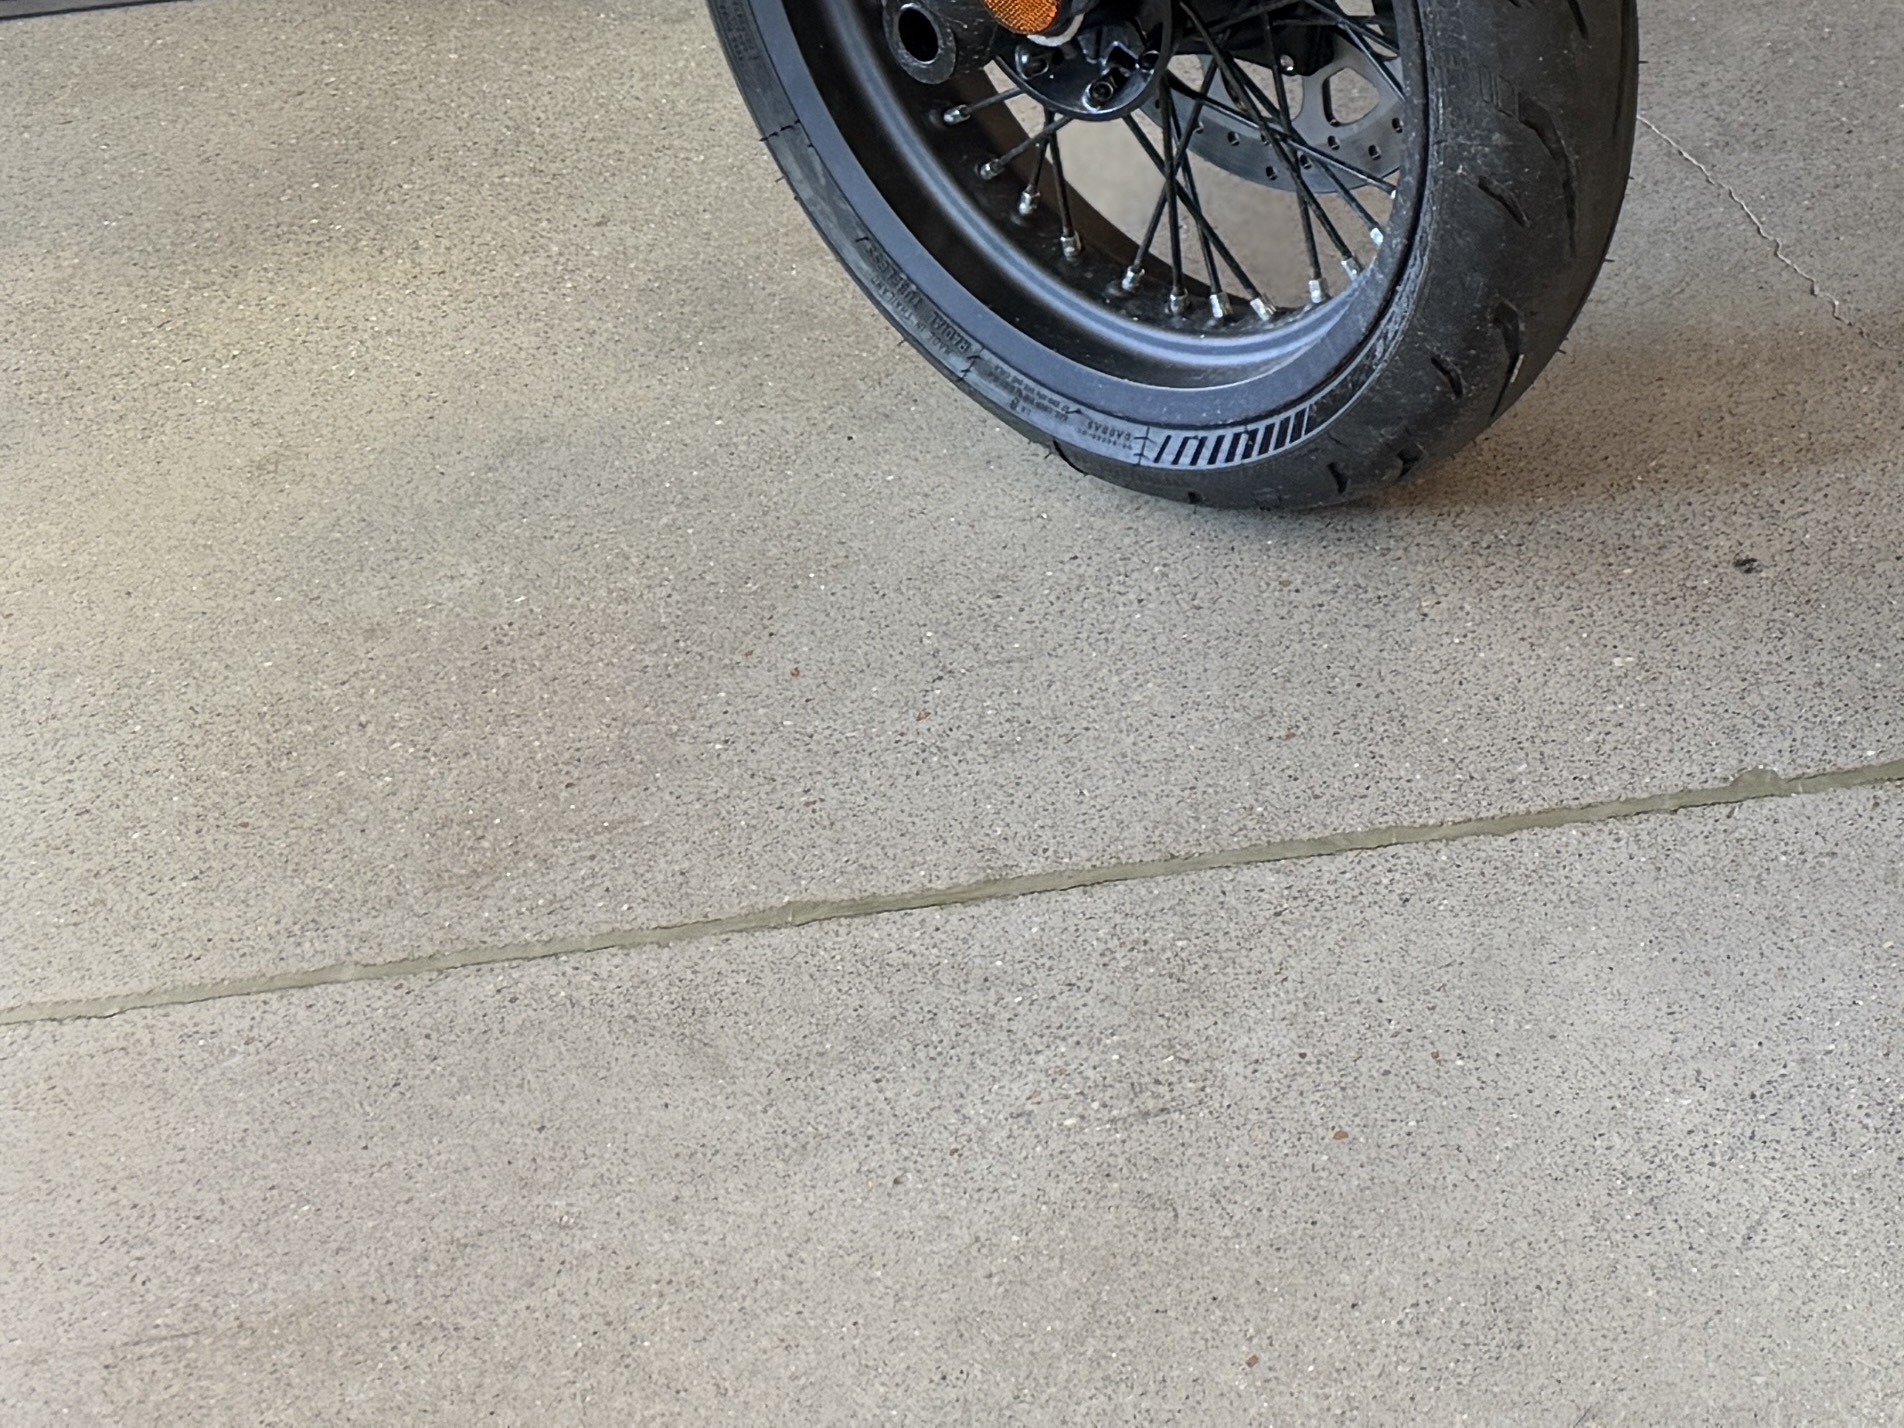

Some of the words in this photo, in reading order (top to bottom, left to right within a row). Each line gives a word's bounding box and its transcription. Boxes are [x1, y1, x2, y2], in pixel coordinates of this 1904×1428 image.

[866, 243, 924, 310] TUBELESS
[870, 275, 913, 321] THAILAND
[927, 331, 951, 356] MADE
[930, 310, 974, 353] RADIAL
